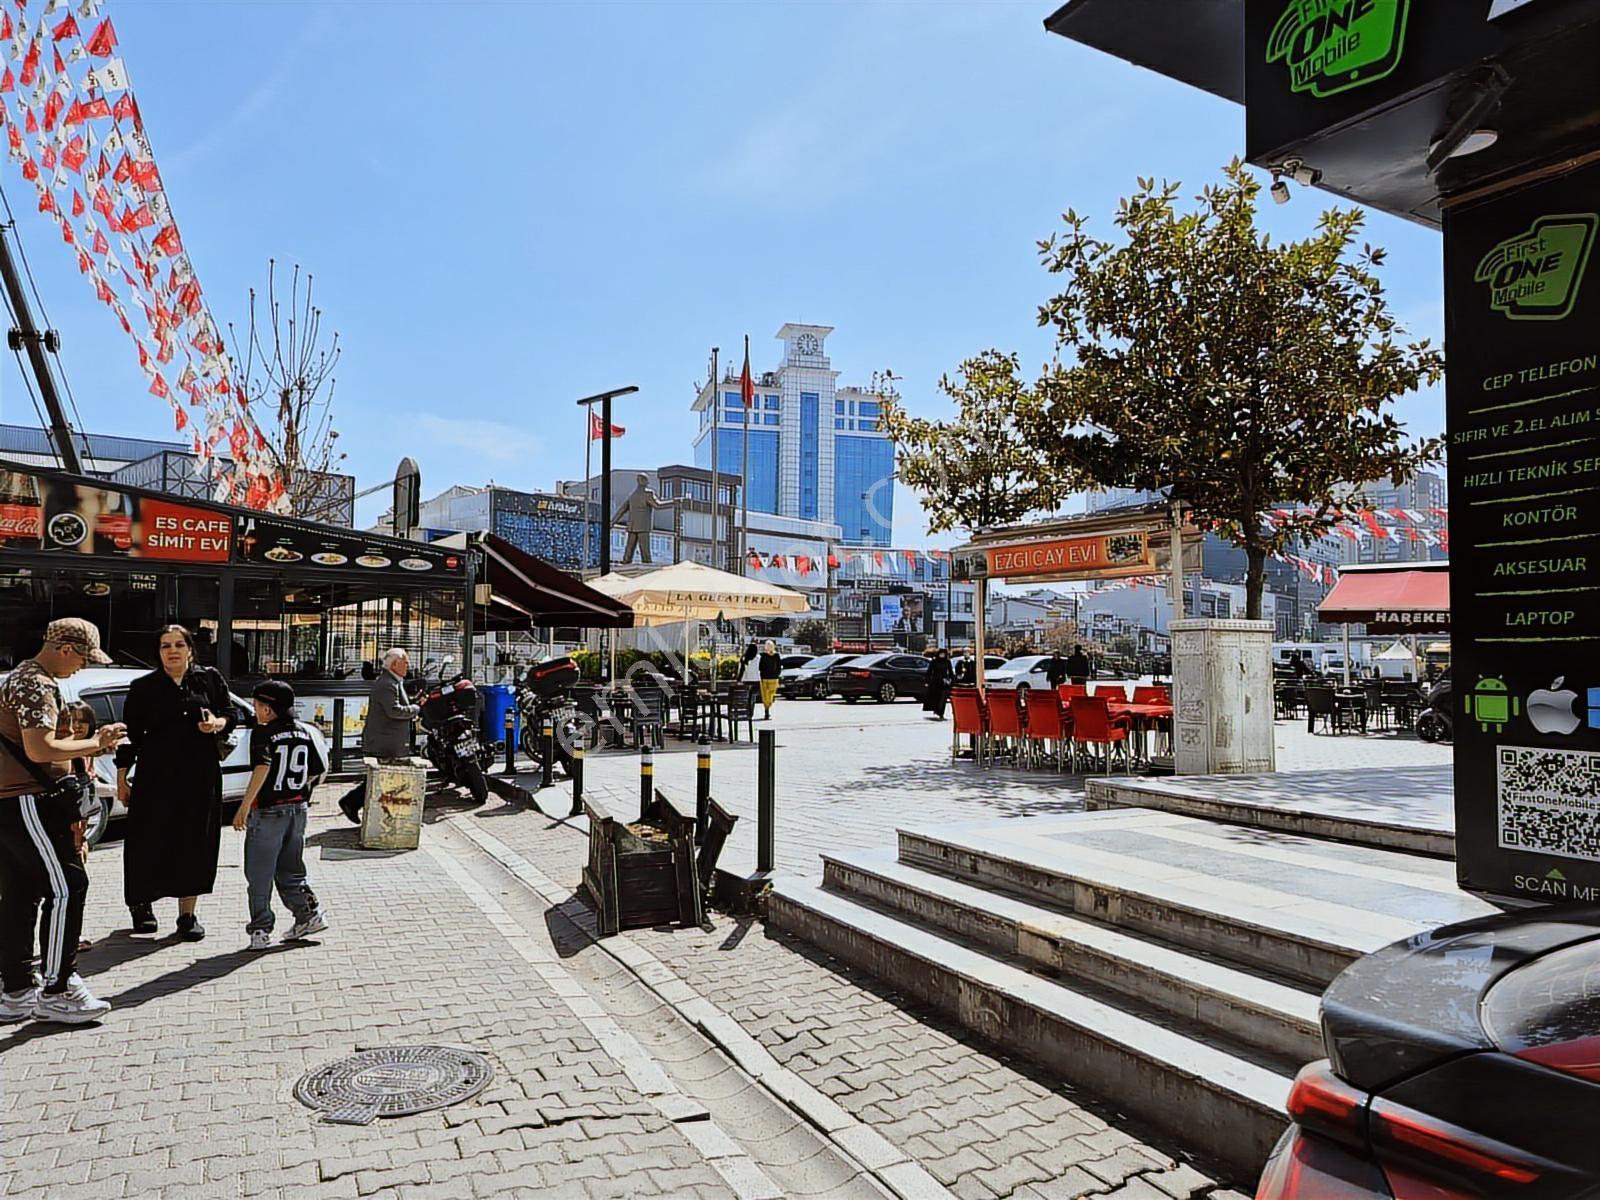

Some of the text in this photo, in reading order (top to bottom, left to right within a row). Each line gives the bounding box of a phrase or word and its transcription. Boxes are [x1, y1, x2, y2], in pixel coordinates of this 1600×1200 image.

[1294, 32, 1361, 83] Mobile
[1506, 238, 1548, 261] First
[1493, 250, 1563, 289] ONE
[1494, 280, 1546, 304] Mobile
[1483, 355, 1597, 391] CEP TELEFON
[1453, 428, 1487, 444] SIFIR
[1492, 424, 1509, 437] VE
[1513, 418, 1547, 434] 2.EL
[1550, 410, 1590, 429] ALIM
[1463, 471, 1502, 487] HIZLI
[1507, 460, 1568, 482] TEKNİK
[156, 517, 230, 533] ES CAFE
[1503, 504, 1577, 527] KONTÖR
[148, 532, 195, 549] SİMİT
[200, 536, 228, 551] EVİ
[1494, 557, 1587, 576] AKSESUAR
[676, 593, 692, 601] LA
[1506, 610, 1575, 626] LAPTOP
[274, 745, 308, 791] 19
[1514, 875, 1567, 897] SCAN
